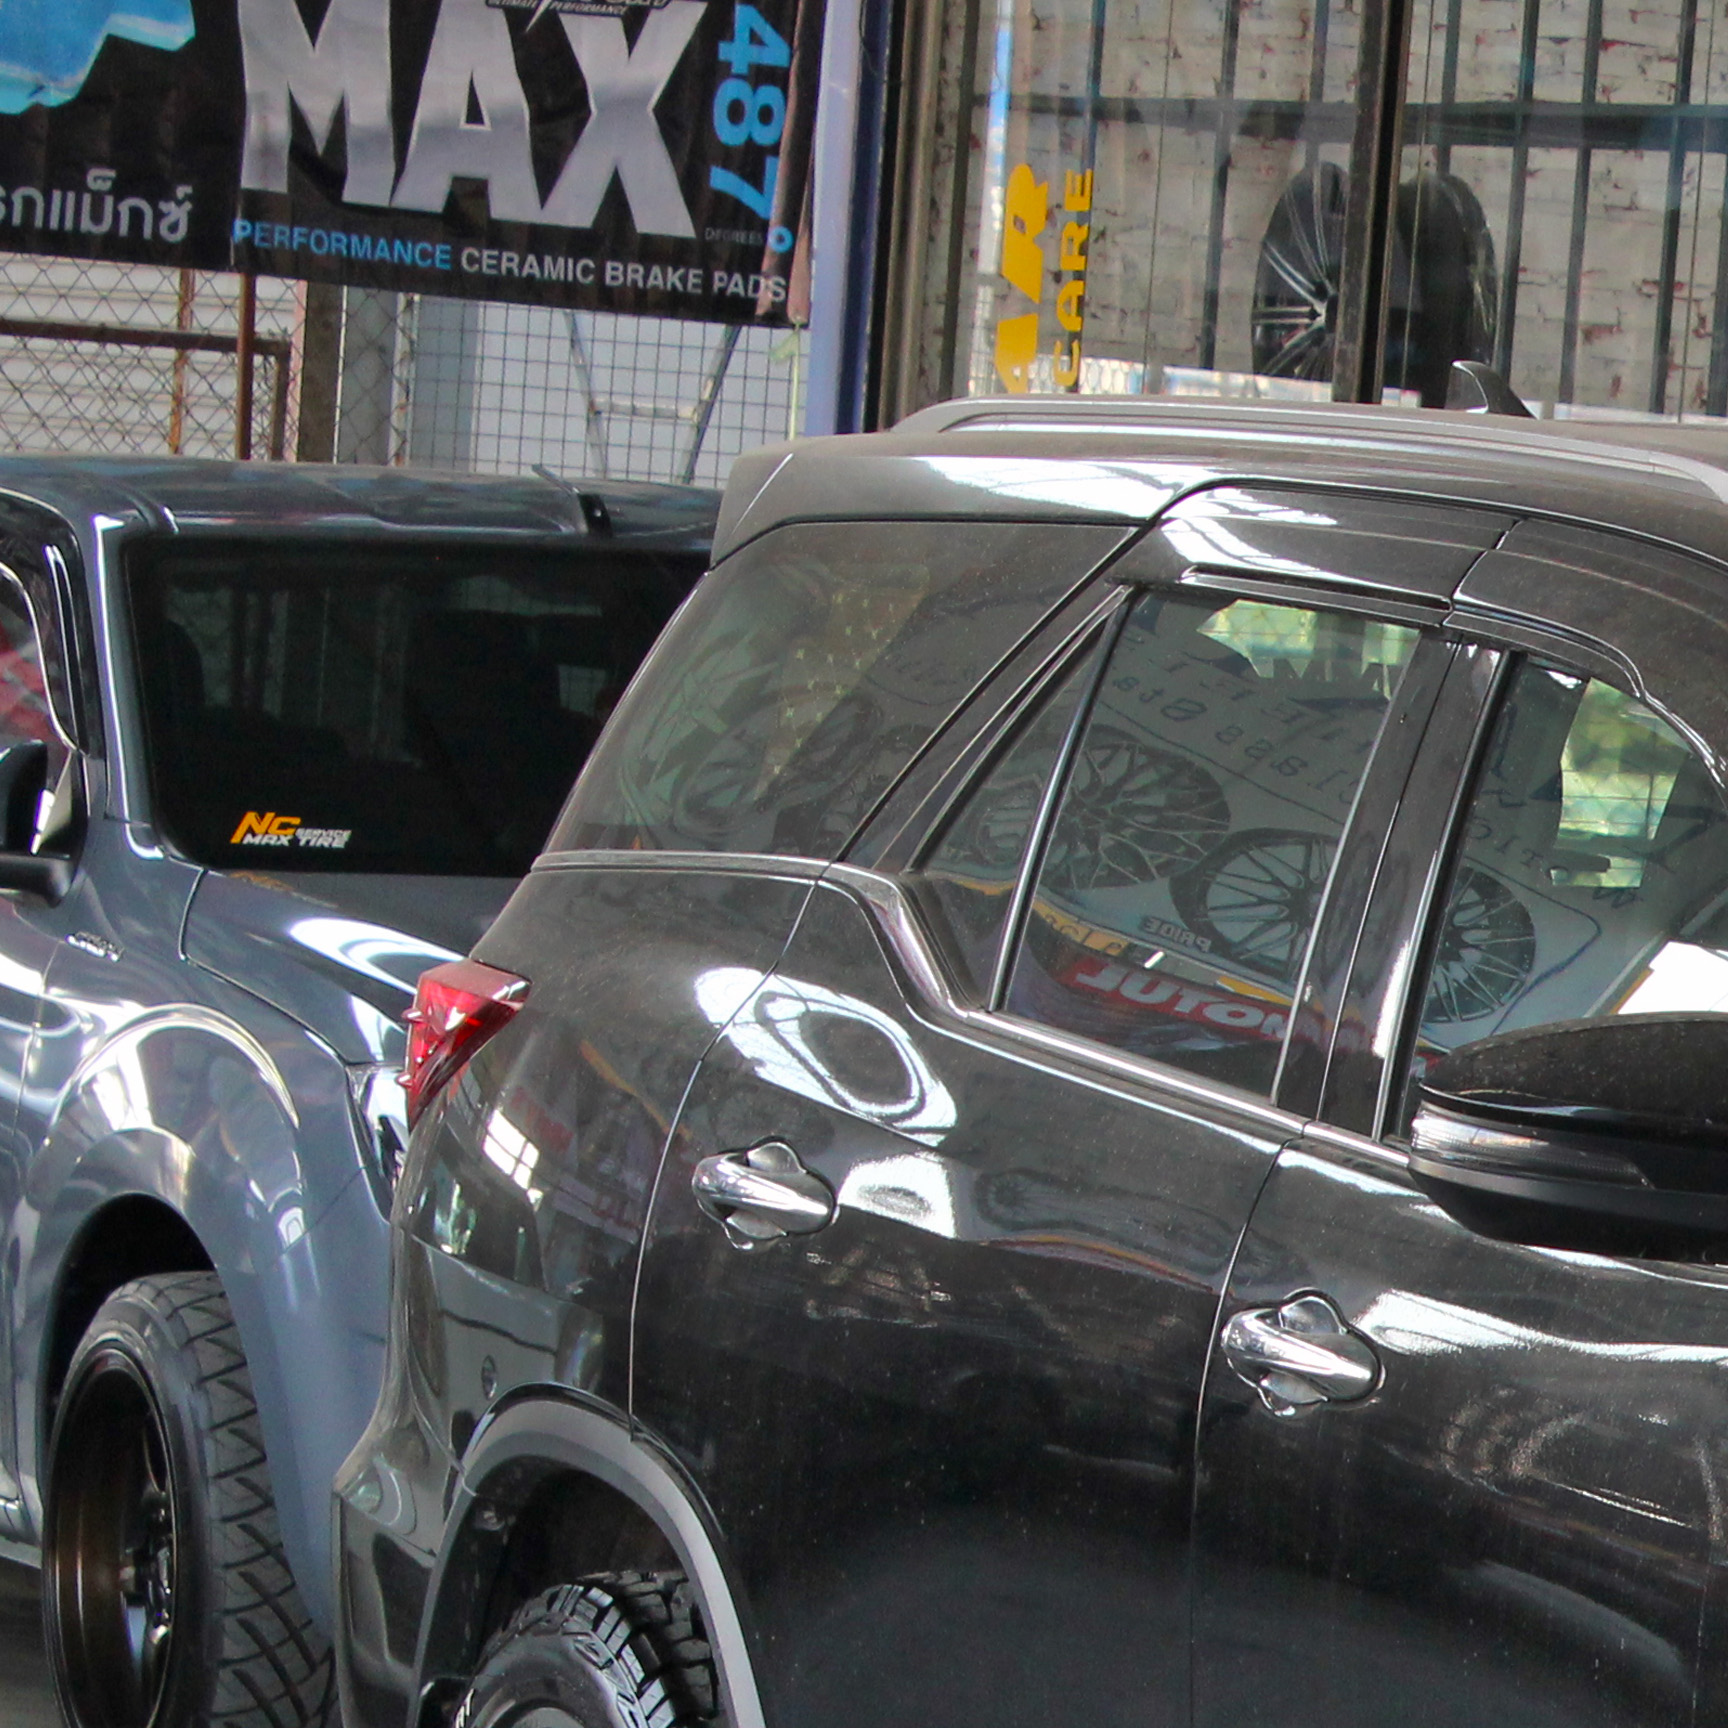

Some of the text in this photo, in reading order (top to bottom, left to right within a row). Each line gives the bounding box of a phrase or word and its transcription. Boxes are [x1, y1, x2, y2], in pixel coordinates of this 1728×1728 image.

[237, 0, 708, 239] MAX
[0, 167, 193, 244] กแม็กซ์
[231, 218, 787, 302] PERFORMANCE CERAMIC BRAKE PADS
[230, 811, 301, 844] NC
[242, 833, 348, 848] MAX TIRE
